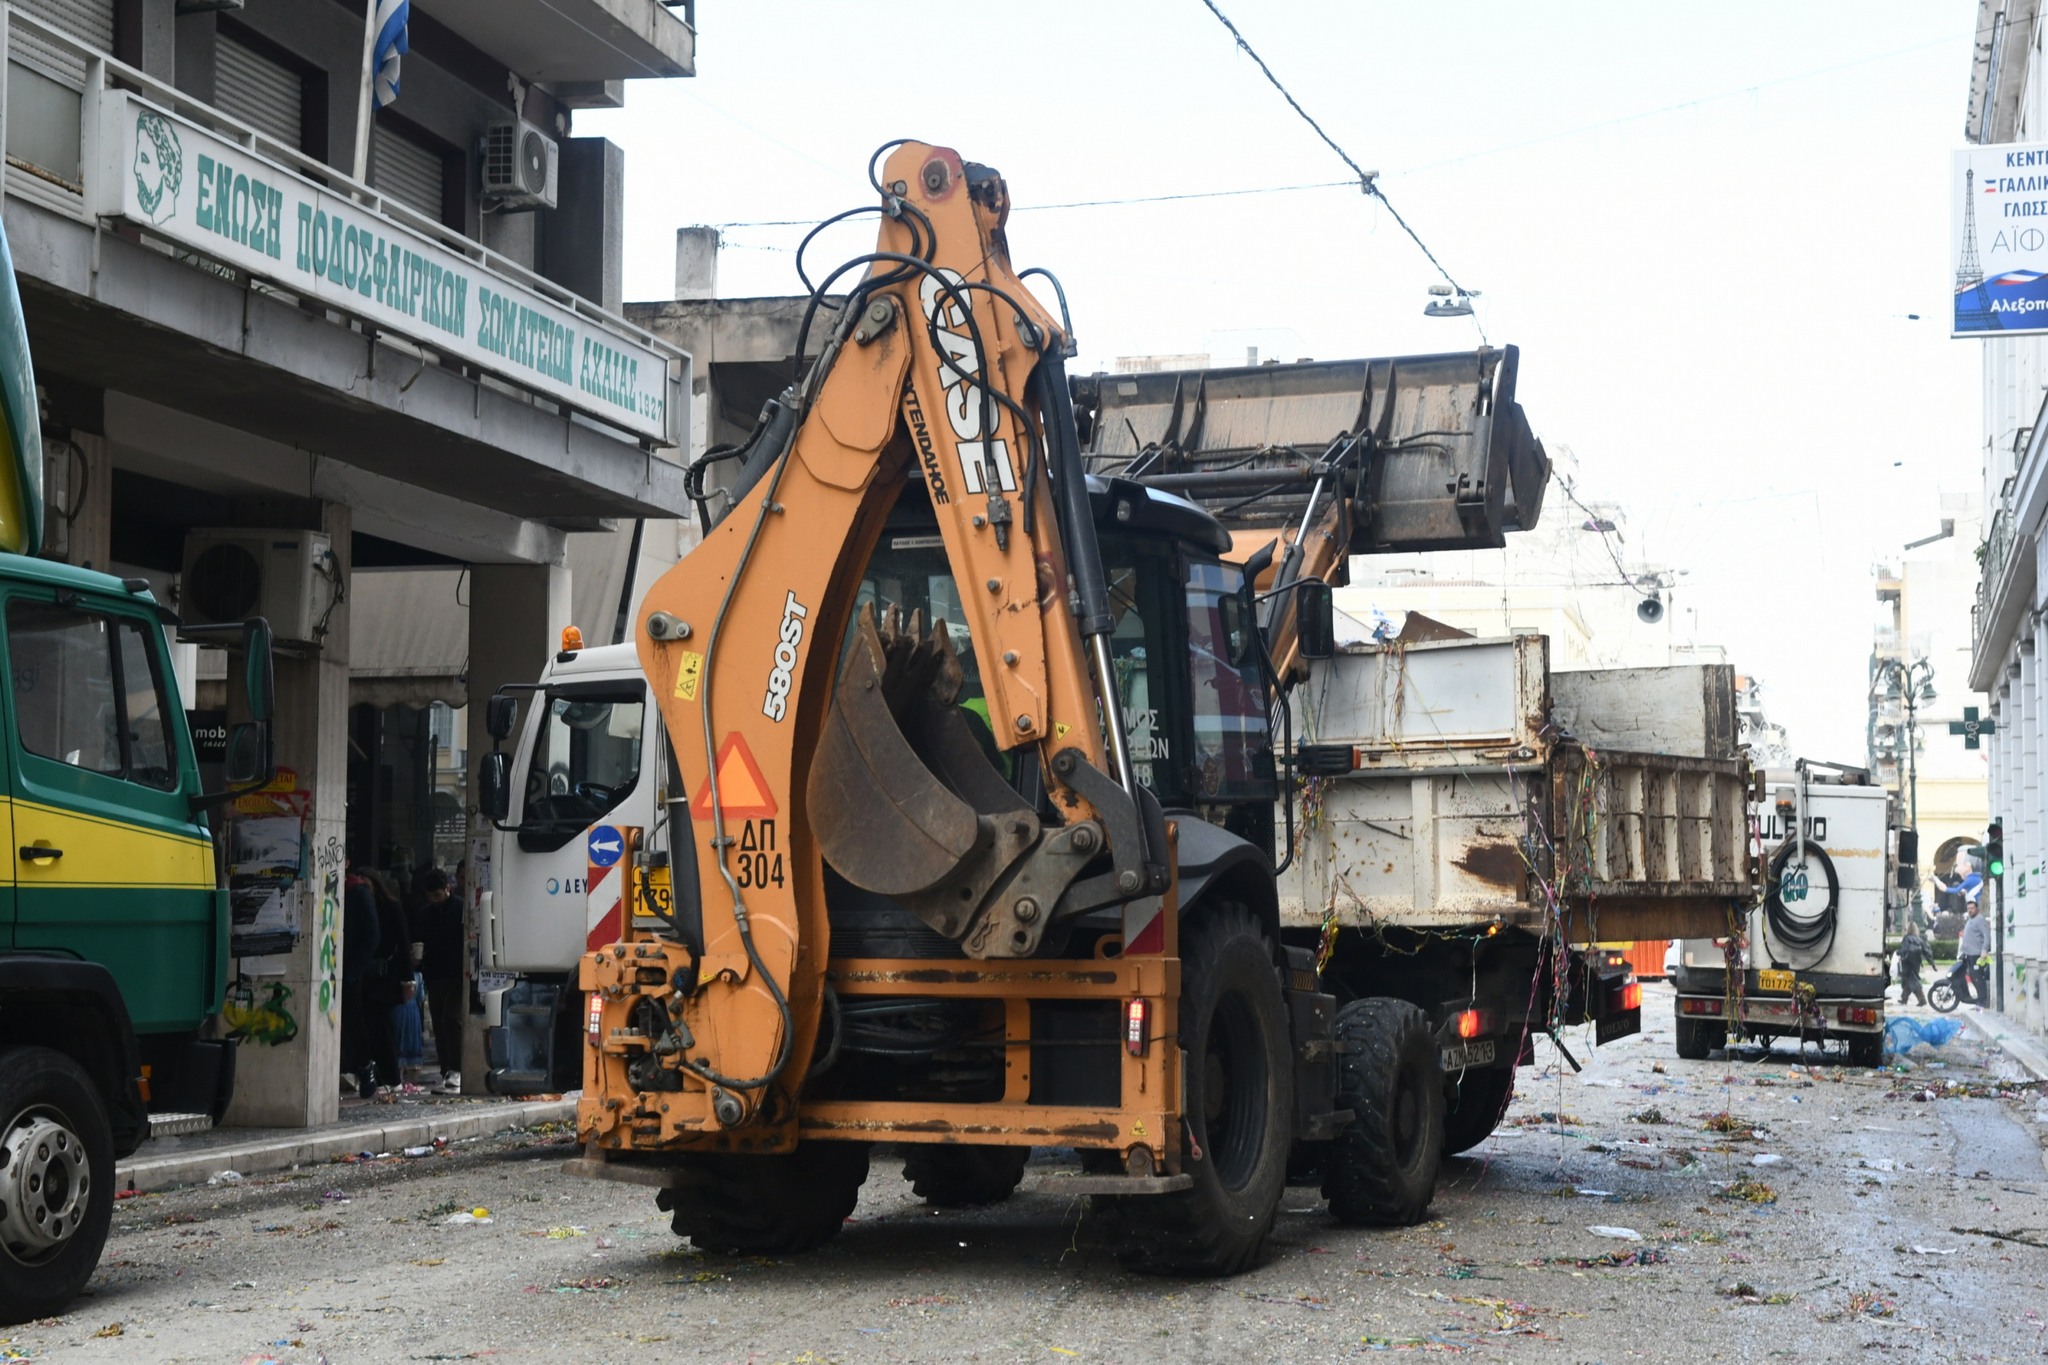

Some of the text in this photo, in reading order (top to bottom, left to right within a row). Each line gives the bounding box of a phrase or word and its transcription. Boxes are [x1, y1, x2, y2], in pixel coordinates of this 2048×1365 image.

[2006, 150, 2048, 168] ΚΕΝΤ
[196, 153, 663, 423] ΕΝΩΣΗ ΠΟΔΟΣΦΑΙΡΙΚΩΝ ΣΩΜΑΤΕΙΩΝ ΑΧΑΙΑΣ 1927
[1989, 297, 2048, 314] Αλεξοπ
[919, 268, 1018, 494] CASE
[902, 372, 950, 505] XTENDAHOE
[762, 589, 808, 723] 580ST
[737, 852, 785, 889] 304
[740, 819, 775, 851] ΔΠ
